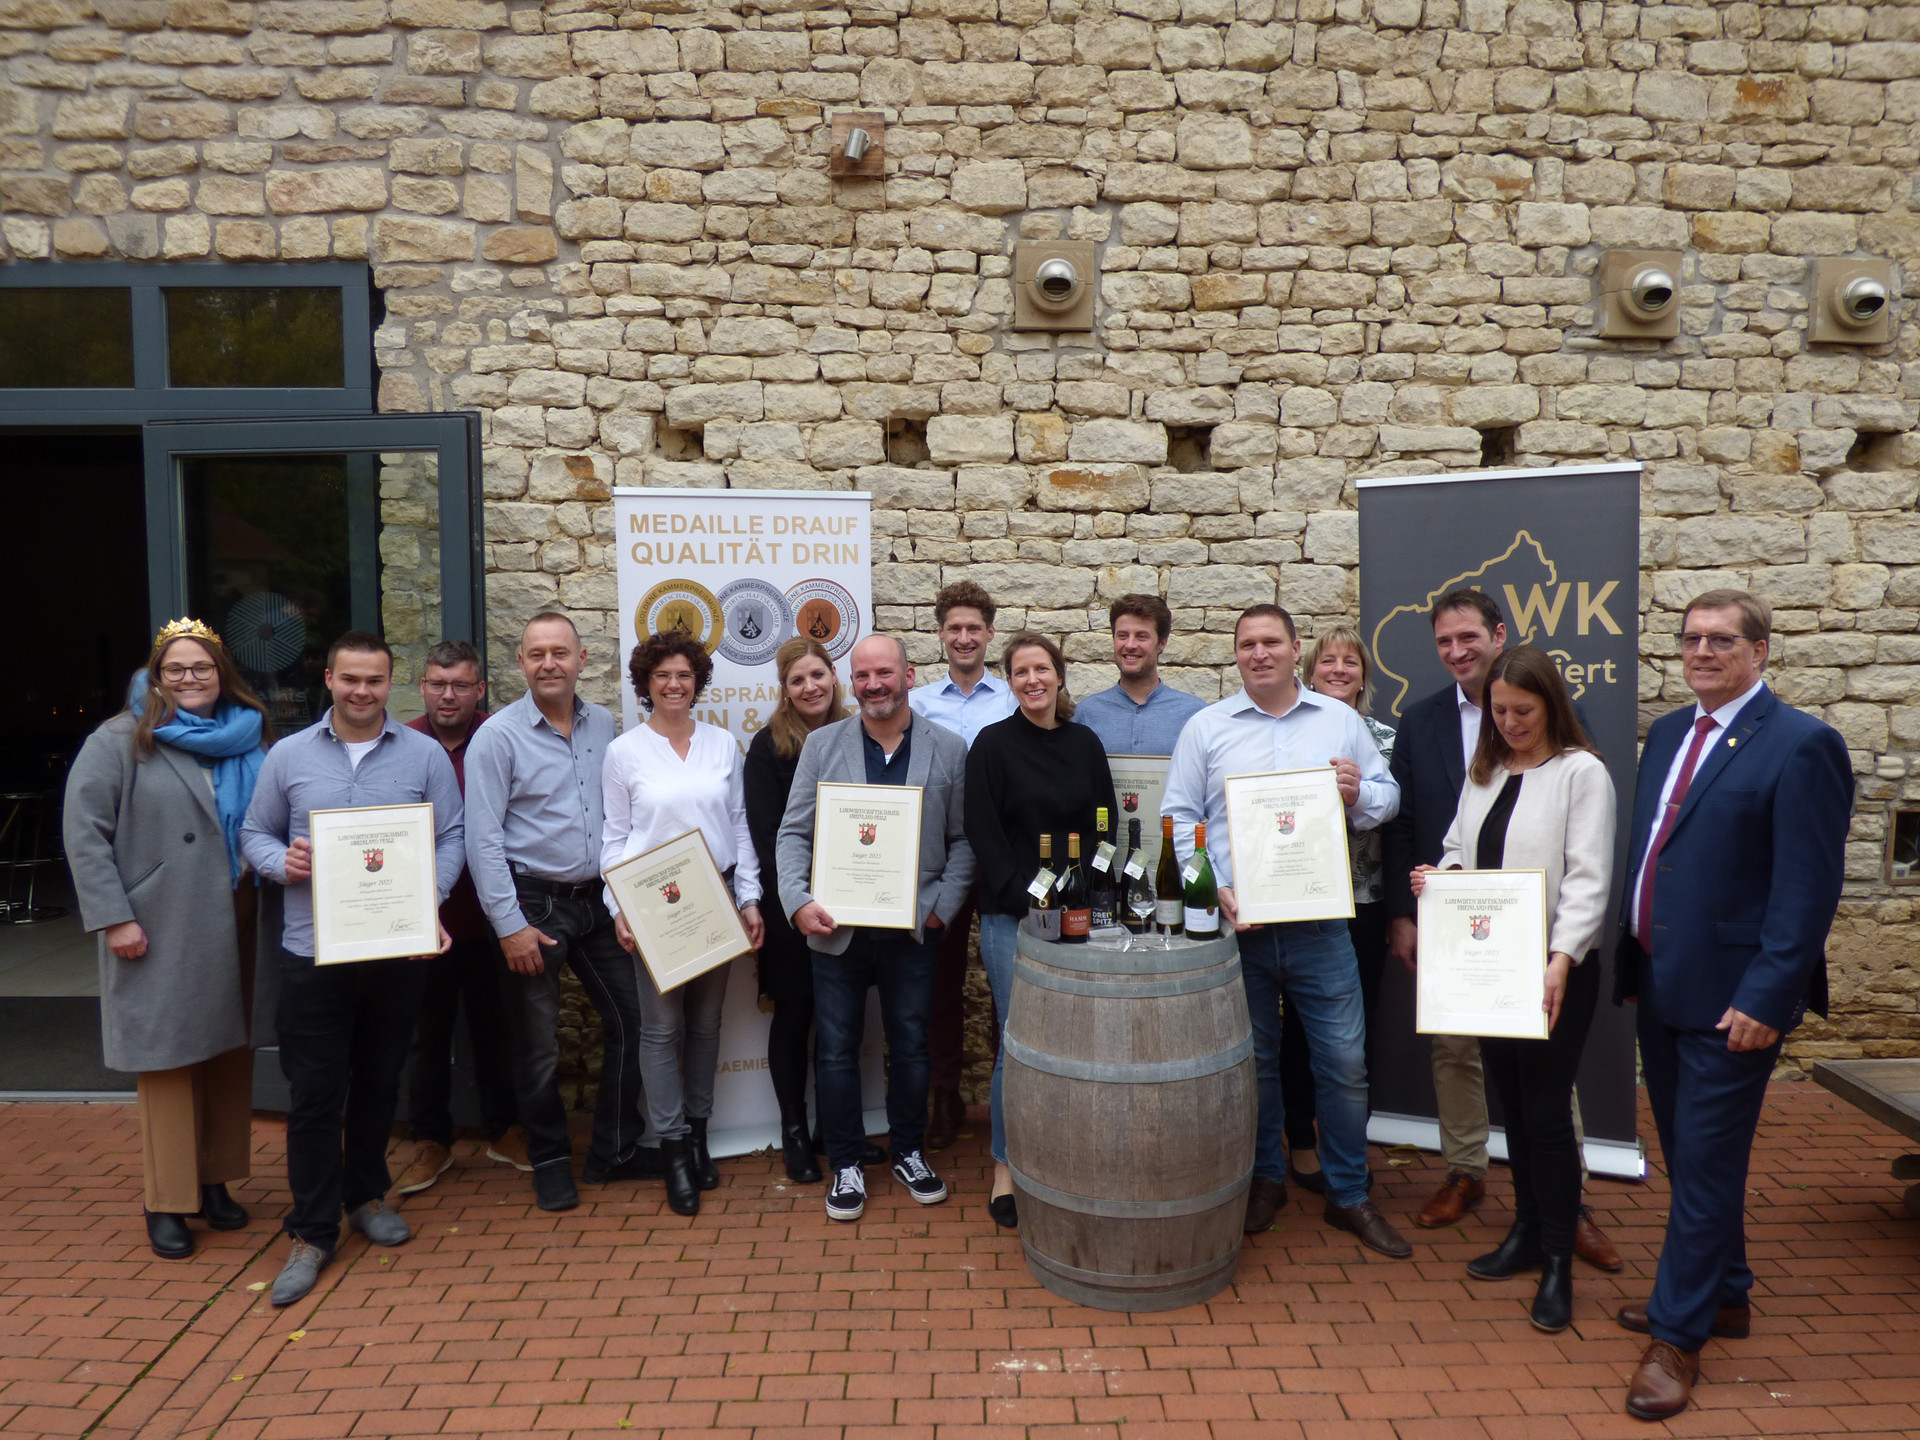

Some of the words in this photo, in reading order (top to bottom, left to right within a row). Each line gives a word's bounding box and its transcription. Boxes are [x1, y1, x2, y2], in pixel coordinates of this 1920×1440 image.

[630, 513, 764, 535] MEDAILLE
[773, 515, 859, 535] DRAUF
[631, 538, 783, 566] QUALITÄT
[792, 543, 859, 565] DRIN
[639, 592, 659, 625] GOLDENE
[658, 583, 720, 623] KAMMERPREISMÜNZE
[649, 592, 711, 629] LANDWIRTSCHAFTSKAMMER
[729, 583, 790, 623] KAMMERPREISMÜNZE
[800, 582, 857, 624] KAMMERPREISMÜNZE
[1471, 580, 1623, 637] WK
[1554, 657, 1617, 684] iert
